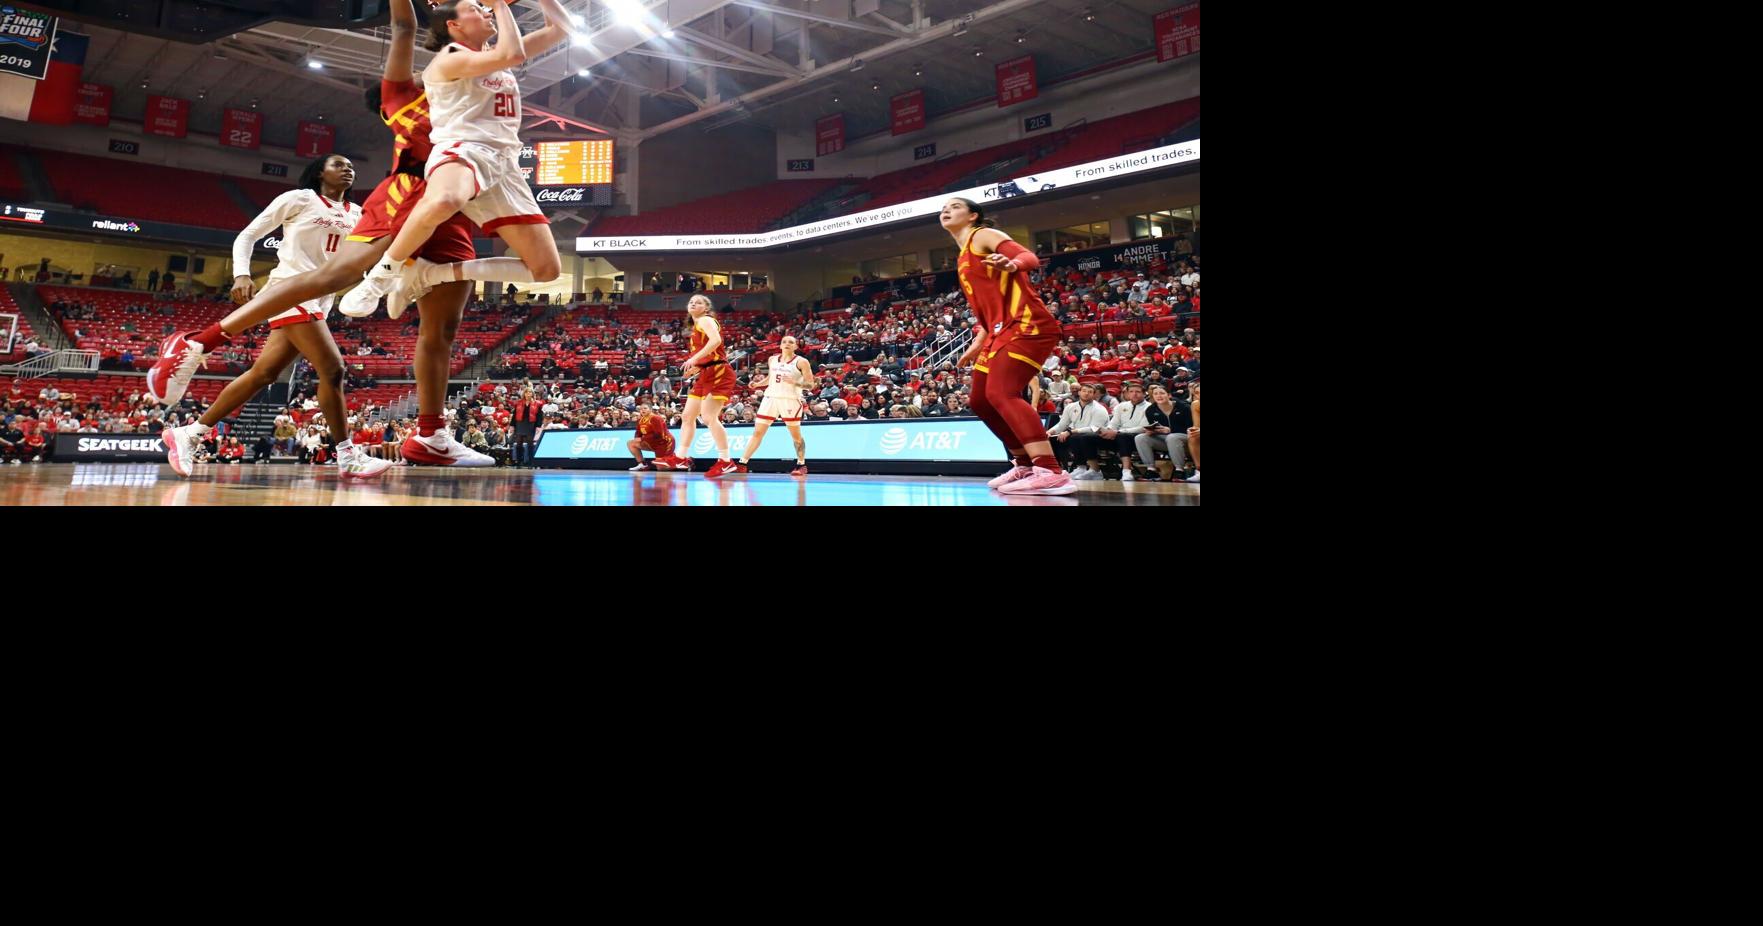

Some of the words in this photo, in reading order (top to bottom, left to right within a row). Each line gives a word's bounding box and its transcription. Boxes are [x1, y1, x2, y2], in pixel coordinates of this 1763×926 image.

[4, 14, 44, 28] FINAL
[0, 24, 42, 37] FOUR
[0, 55, 31, 68] 2019
[494, 93, 516, 117] 20
[1030, 116, 1046, 128] 215
[230, 130, 252, 143] 22
[114, 143, 134, 152] 210
[1075, 166, 1105, 178] From
[1108, 156, 1148, 171] skilled
[983, 187, 997, 198] KT
[92, 220, 129, 231] reliant
[313, 217, 333, 228] Lady
[609, 239, 647, 247] BLACK
[676, 238, 701, 246] From
[704, 237, 735, 245] skilled
[805, 226, 821, 234] data
[880, 210, 895, 221] got
[896, 207, 913, 217] you
[326, 233, 340, 252] 11
[1123, 243, 1159, 256] ANDRE
[1113, 253, 1123, 262] 14
[1124, 251, 1167, 264] MMET
[1078, 260, 1101, 270] HONOR
[77, 438, 163, 452] SEATGEEK
[586, 437, 620, 451] AT&T
[909, 431, 967, 449] AT&T
